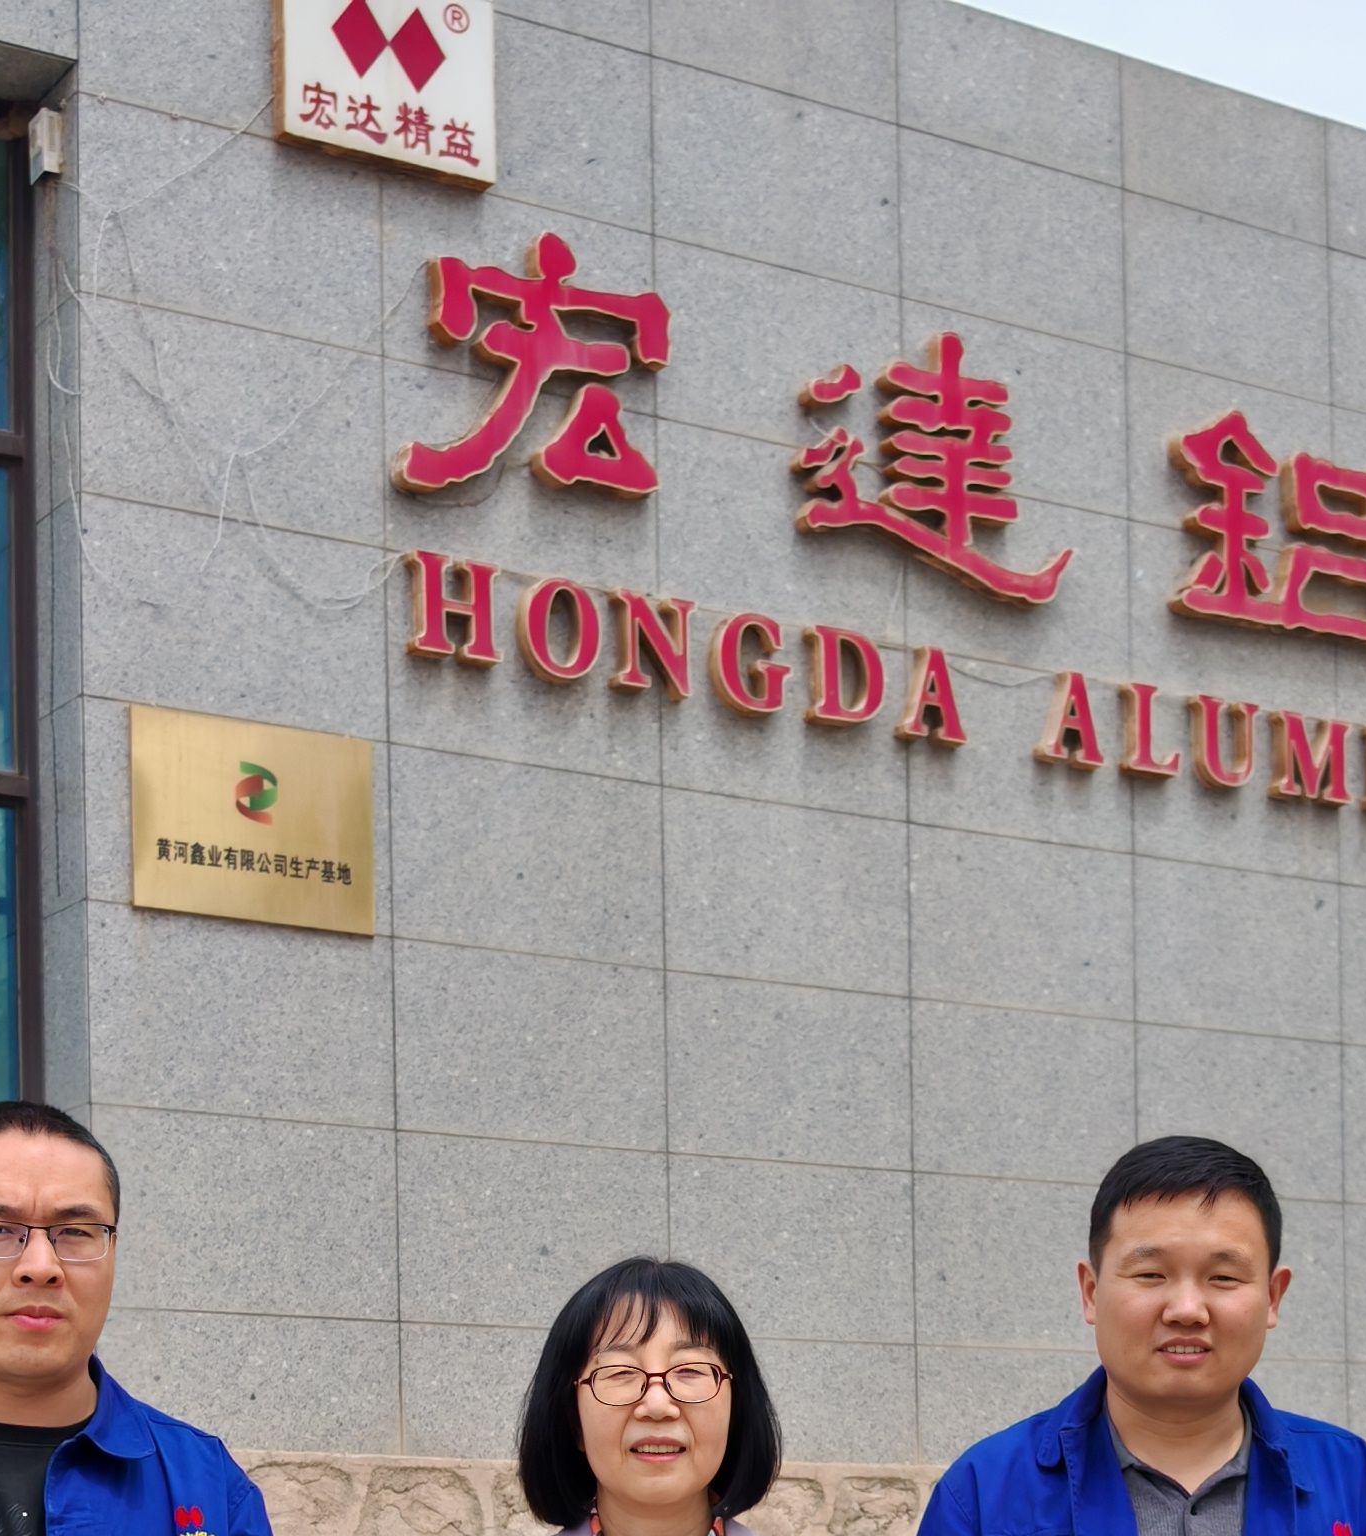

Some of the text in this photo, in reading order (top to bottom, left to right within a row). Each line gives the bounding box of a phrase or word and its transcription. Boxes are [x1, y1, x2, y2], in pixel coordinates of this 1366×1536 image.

[299, 82, 480, 168] 宏达精益
[406, 549, 968, 749] HONGDA
[156, 838, 353, 886] 黄河鑫业有限公司生产基地
